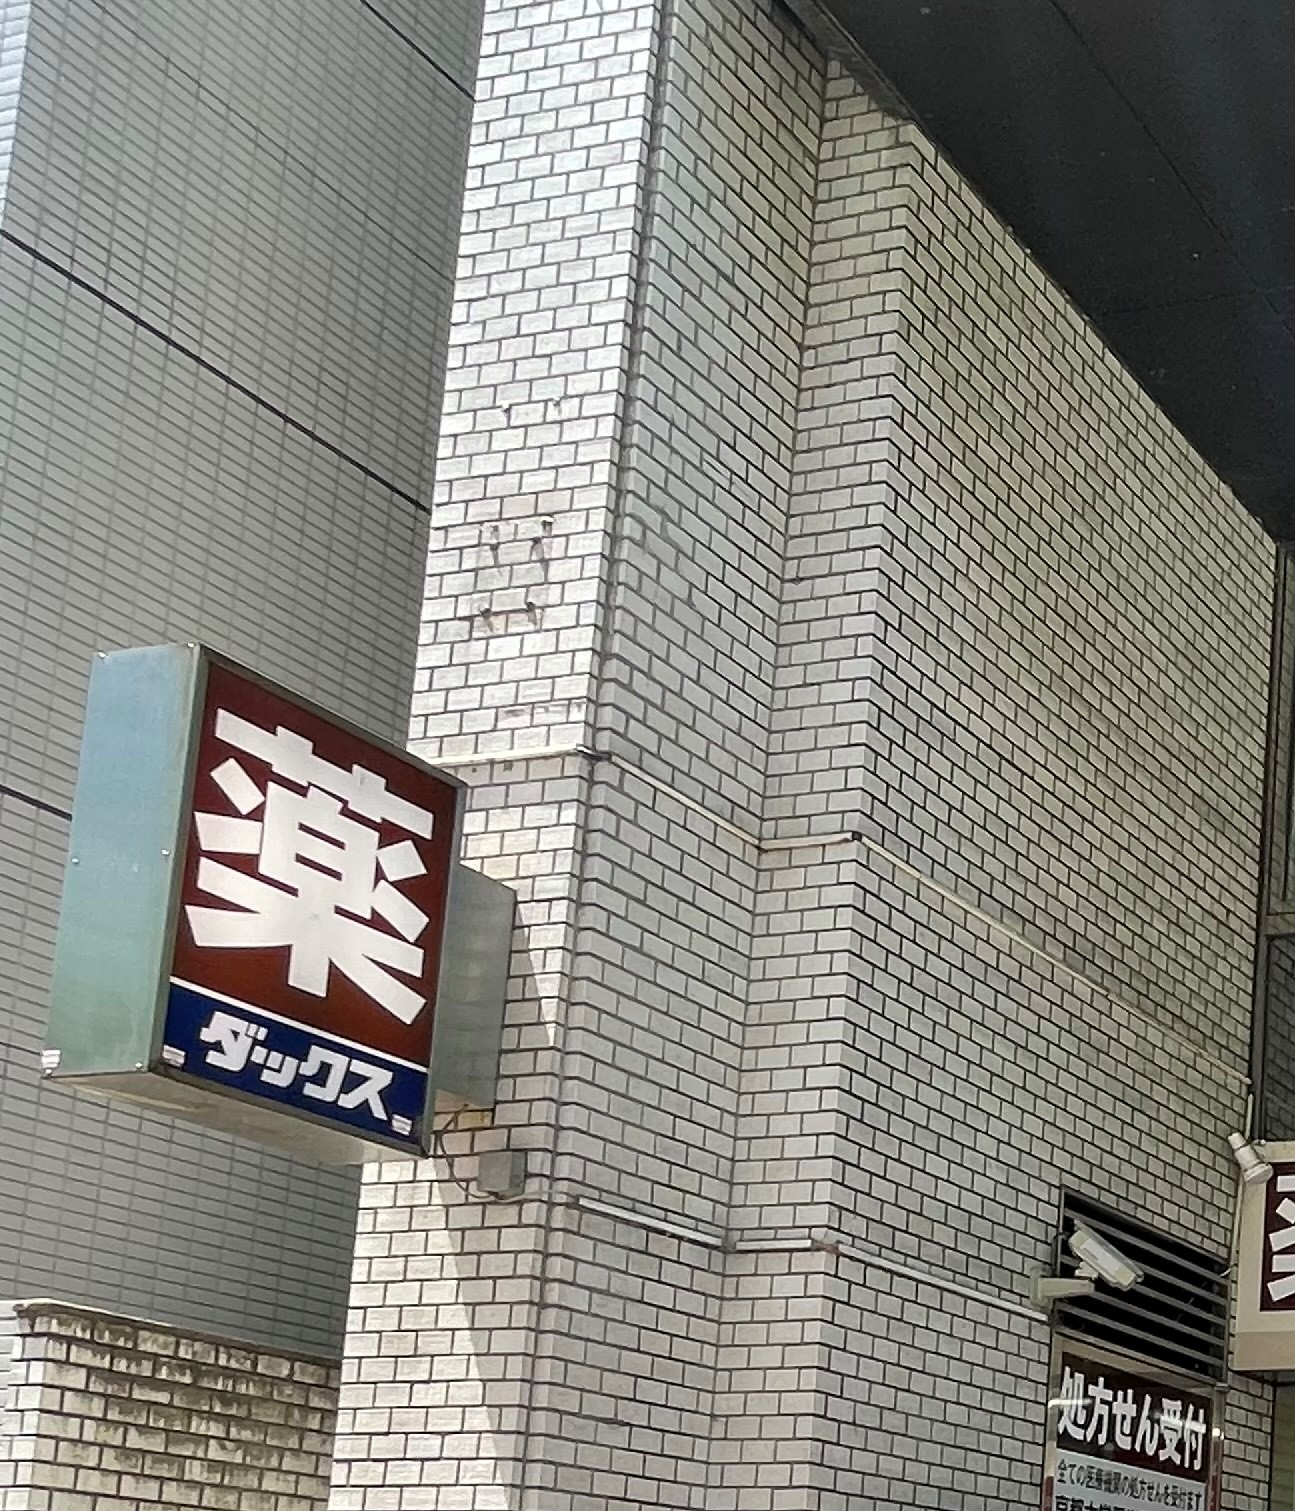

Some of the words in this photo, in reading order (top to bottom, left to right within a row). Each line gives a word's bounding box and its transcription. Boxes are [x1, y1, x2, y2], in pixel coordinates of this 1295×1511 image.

[185, 707, 434, 1025] 薬
[199, 1010, 393, 1121] ダックス
[1058, 1365, 1207, 1471] 処方せん受付
